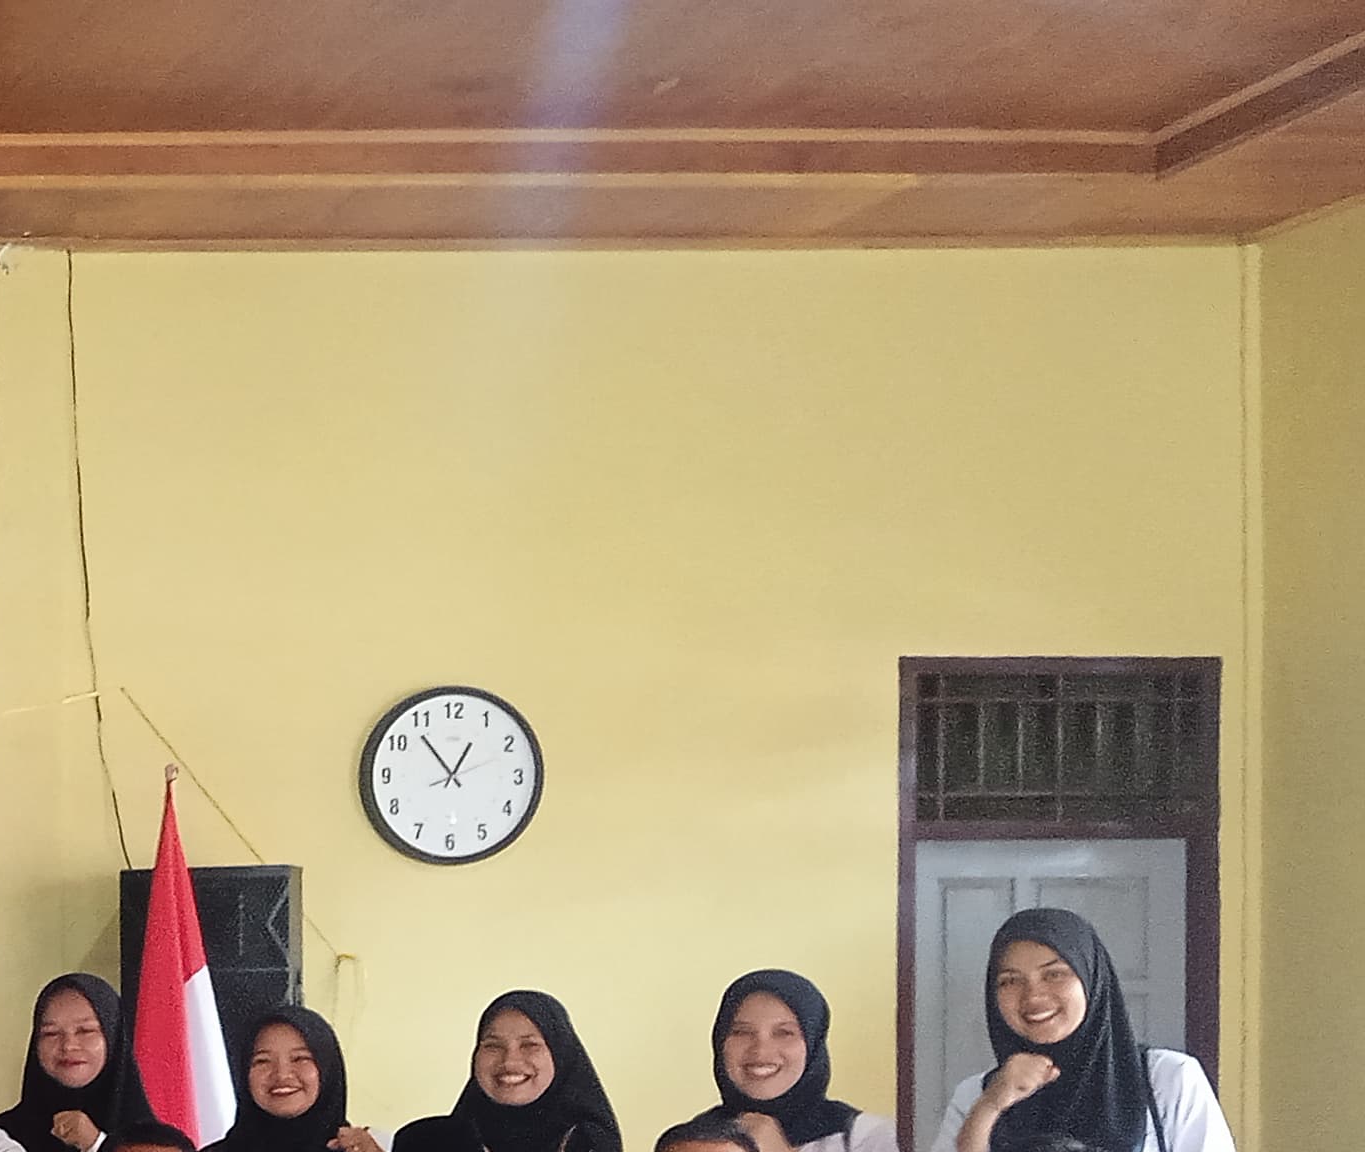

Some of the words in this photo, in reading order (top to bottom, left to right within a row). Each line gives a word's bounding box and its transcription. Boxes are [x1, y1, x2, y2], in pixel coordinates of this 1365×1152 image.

[444, 702, 464, 719] 12
[412, 711, 430, 728] 11
[482, 711, 490, 728] 1
[388, 735, 407, 751] 10
[504, 735, 515, 752] 2
[381, 767, 391, 784] 9
[513, 768, 524, 785] 3
[389, 798, 399, 815] 8
[502, 800, 512, 816] 4
[413, 823, 424, 840] 7
[477, 824, 488, 840] 5
[445, 834, 455, 850] 6
